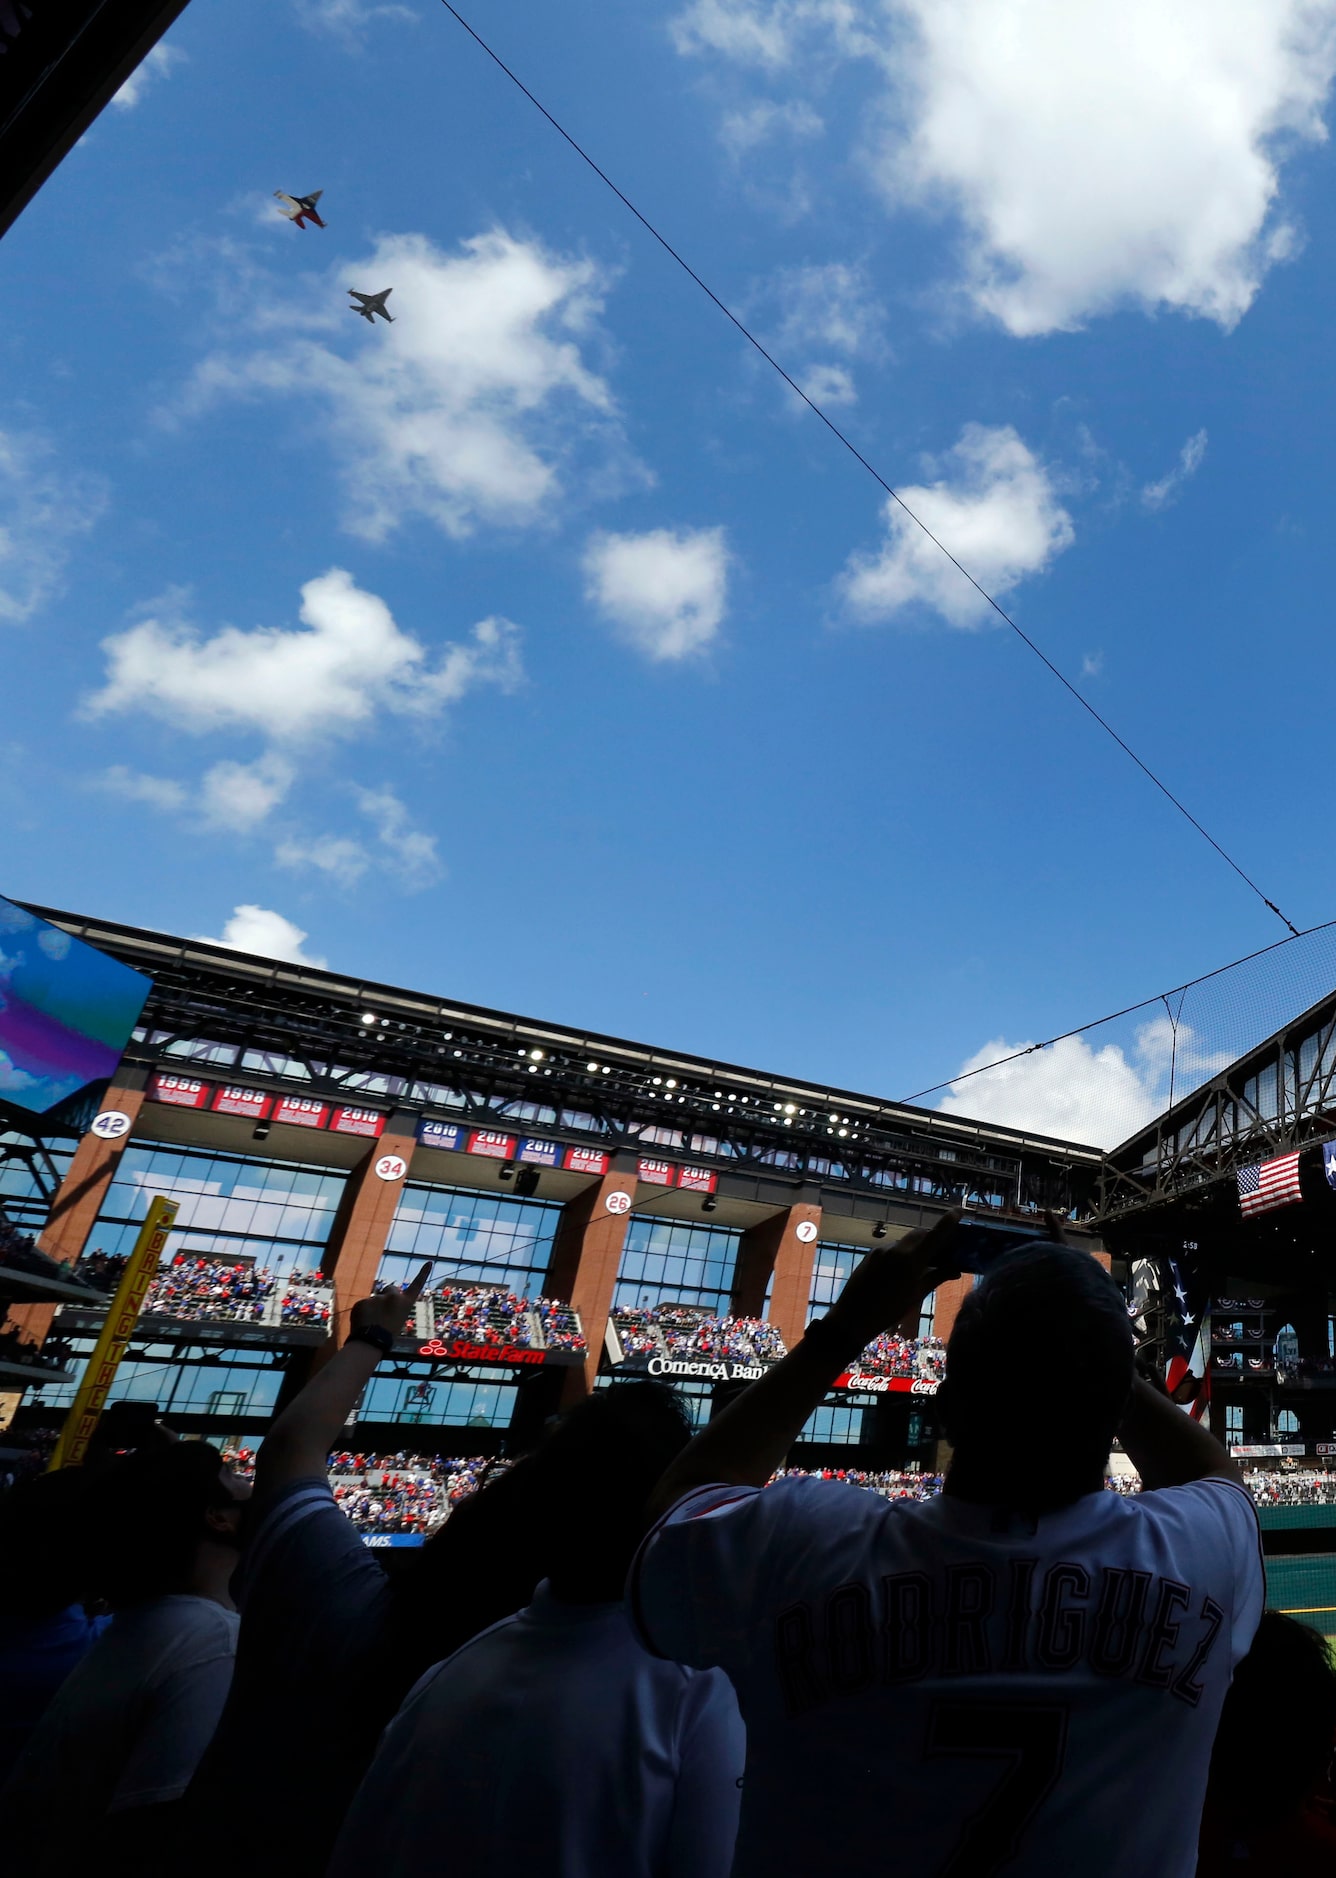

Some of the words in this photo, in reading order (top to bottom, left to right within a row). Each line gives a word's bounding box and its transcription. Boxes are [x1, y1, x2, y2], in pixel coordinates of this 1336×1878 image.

[157, 1074, 202, 1093] 1996
[282, 1095, 323, 1113] 1999
[341, 1106, 379, 1123] 2010
[96, 1116, 124, 1133] 42
[424, 1121, 458, 1137] 2010
[477, 1130, 507, 1145] 2011
[526, 1138, 556, 1154] 2011
[573, 1146, 604, 1161] 2012
[379, 1160, 401, 1176] 34
[640, 1158, 669, 1174] 2015
[608, 1195, 627, 1210] 26
[803, 1225, 811, 1238] 7
[115, 1231, 164, 1336] BRING
[89, 1345, 122, 1408] THE
[775, 1558, 1225, 1720] RODRIGUEZ
[920, 1698, 1070, 1878] 7
